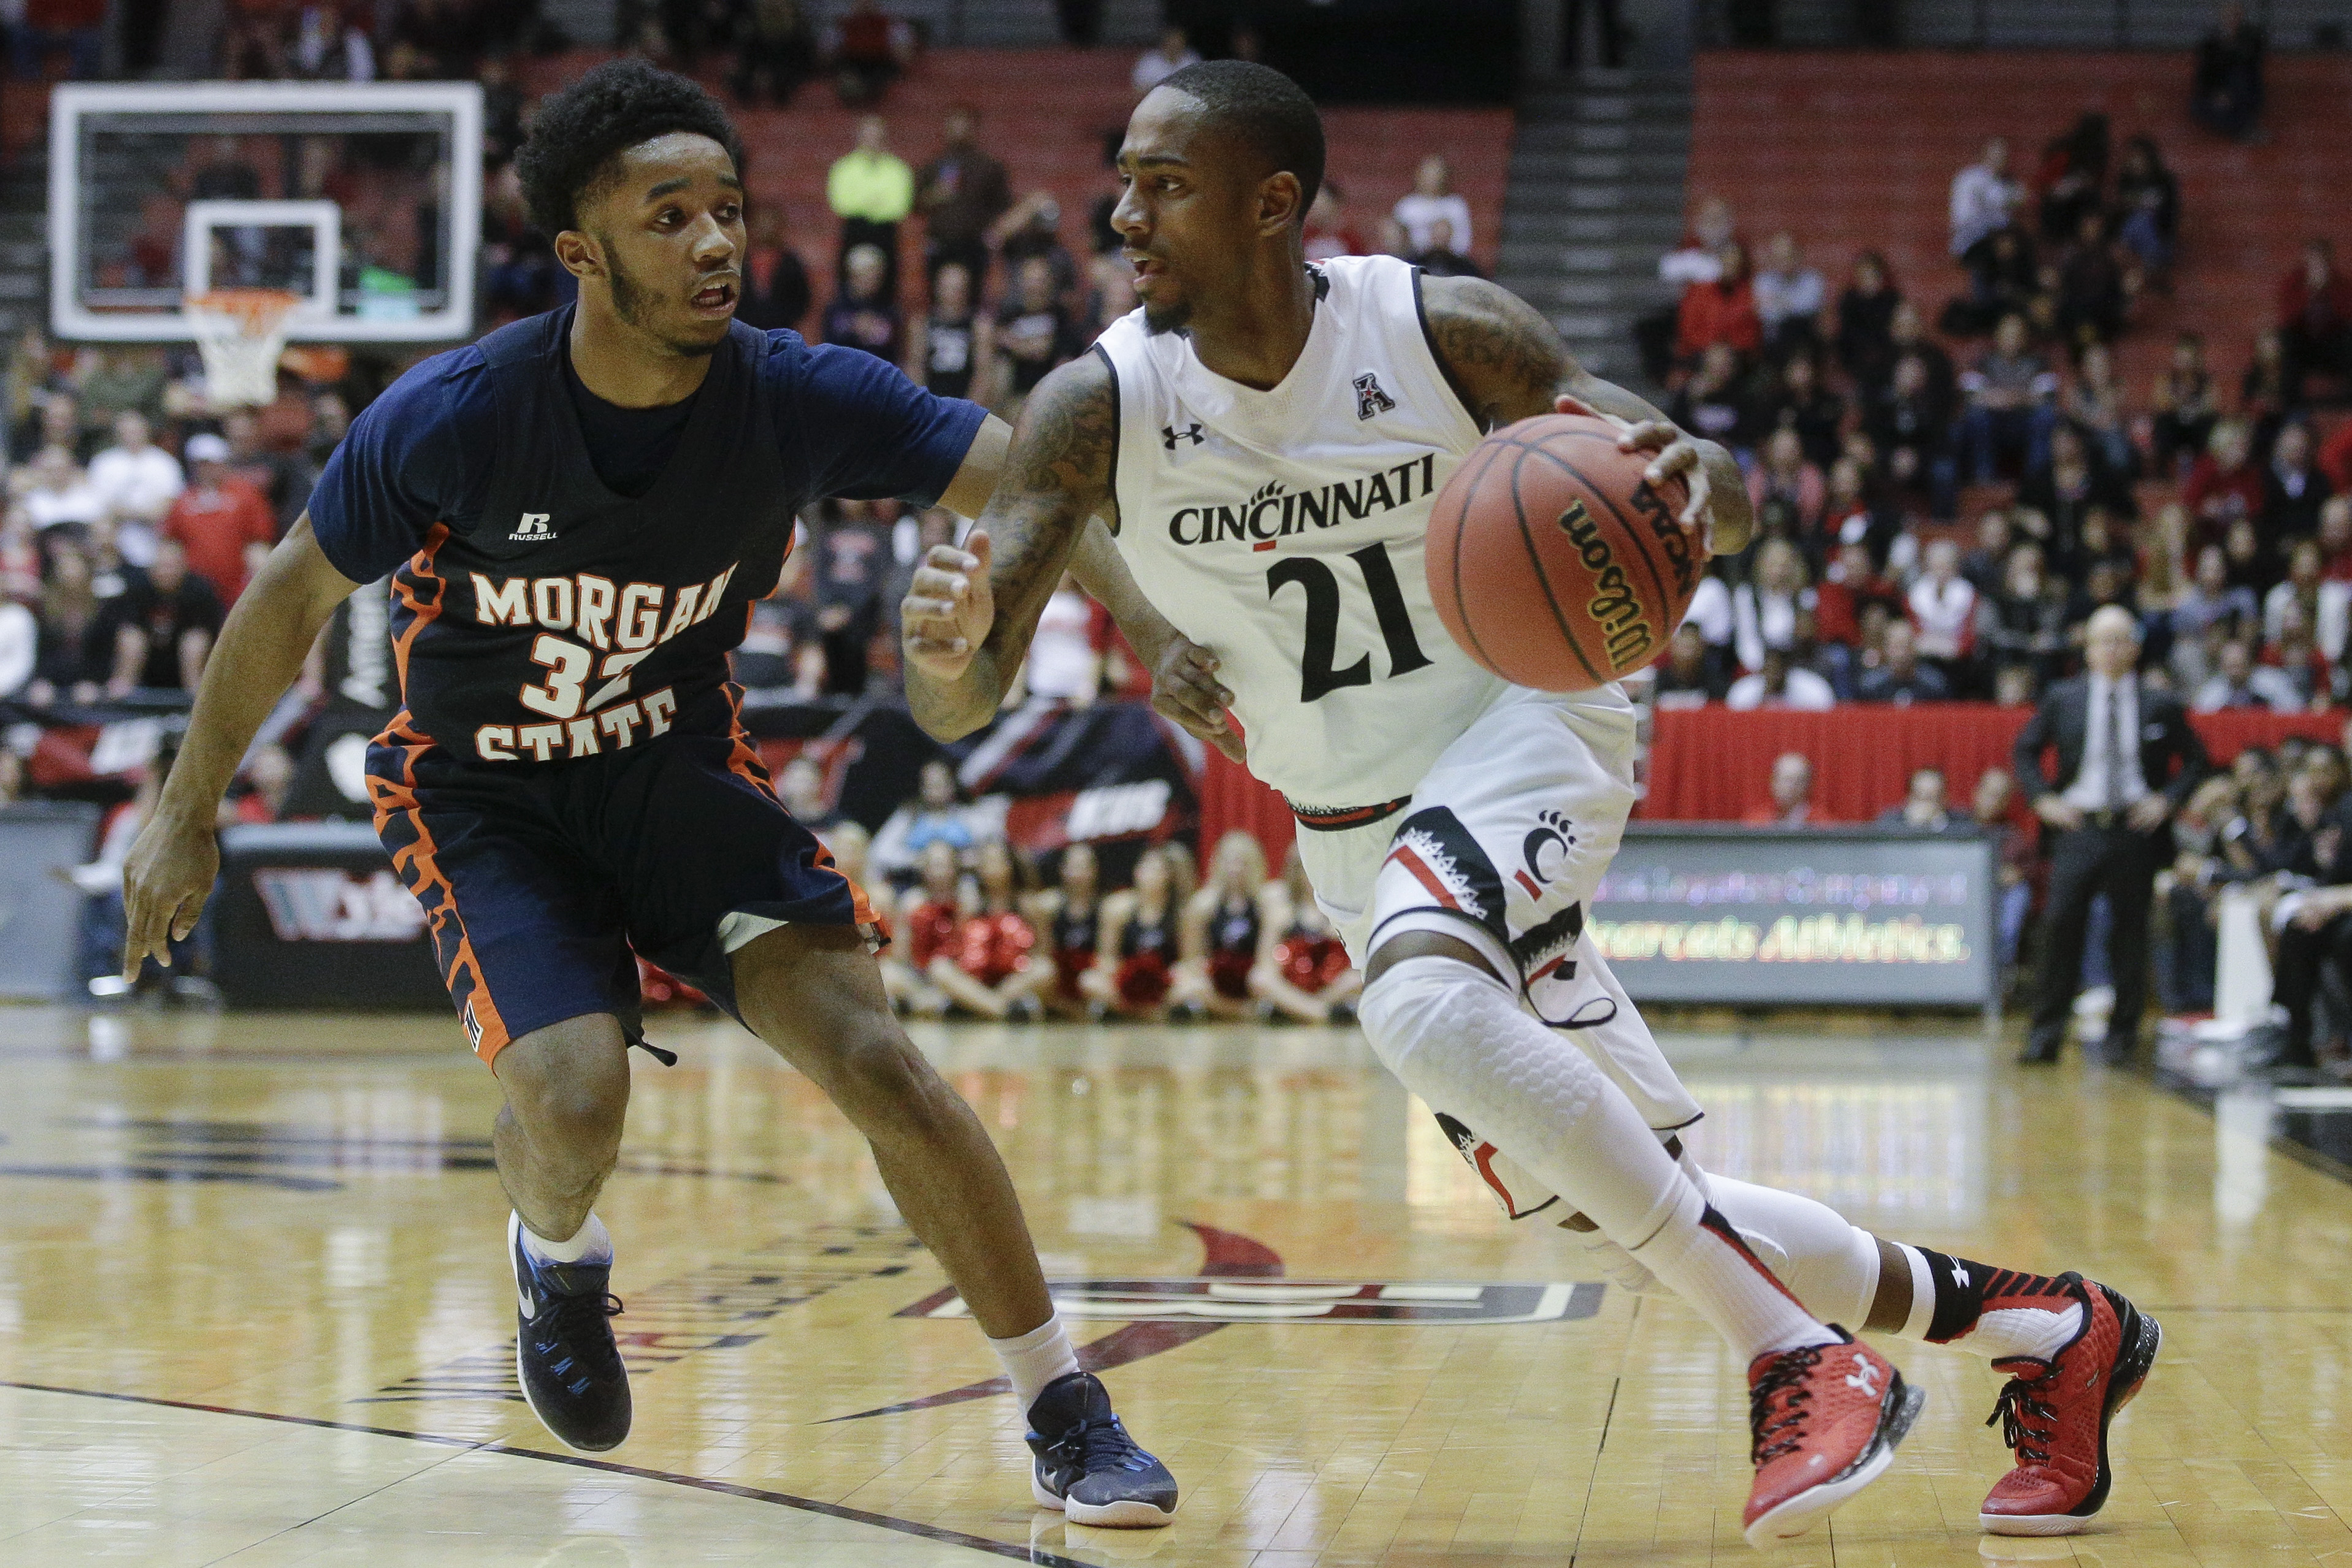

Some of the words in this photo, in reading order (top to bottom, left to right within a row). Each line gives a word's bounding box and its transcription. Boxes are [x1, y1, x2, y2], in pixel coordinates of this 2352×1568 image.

[508, 532, 557, 541] RUSSELL
[1169, 453, 1435, 546] CINCINNATI
[1630, 479, 1695, 599] NCAA
[469, 560, 740, 651] MORGAN
[1267, 541, 1435, 703] 21
[1558, 497, 1652, 671] Wilson
[519, 632, 656, 720] 32
[475, 686, 676, 762] STATE
